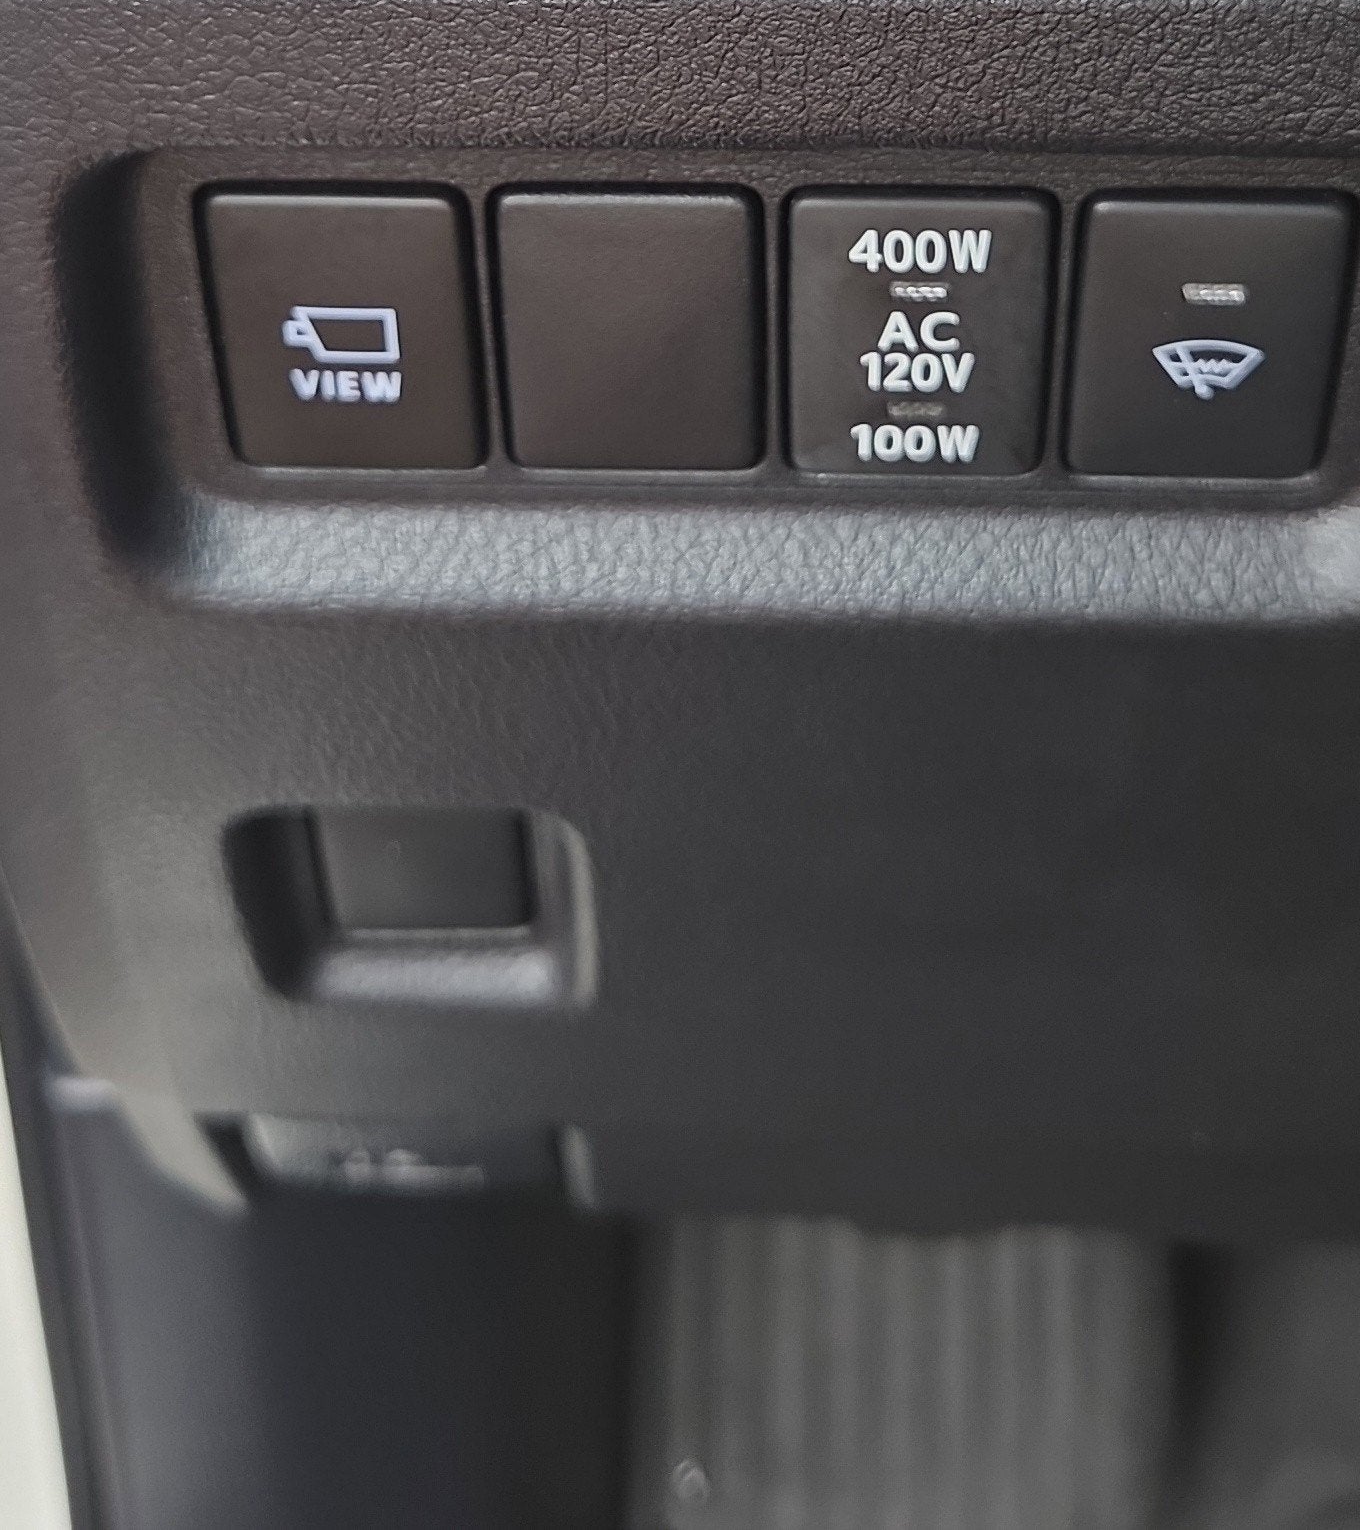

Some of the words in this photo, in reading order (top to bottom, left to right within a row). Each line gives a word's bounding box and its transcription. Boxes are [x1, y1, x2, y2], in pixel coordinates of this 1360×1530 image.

[848, 229, 992, 274] 400W
[877, 311, 960, 349] AC
[290, 368, 402, 402] VIEW
[859, 351, 975, 393] 120V
[849, 423, 980, 463] 100W
